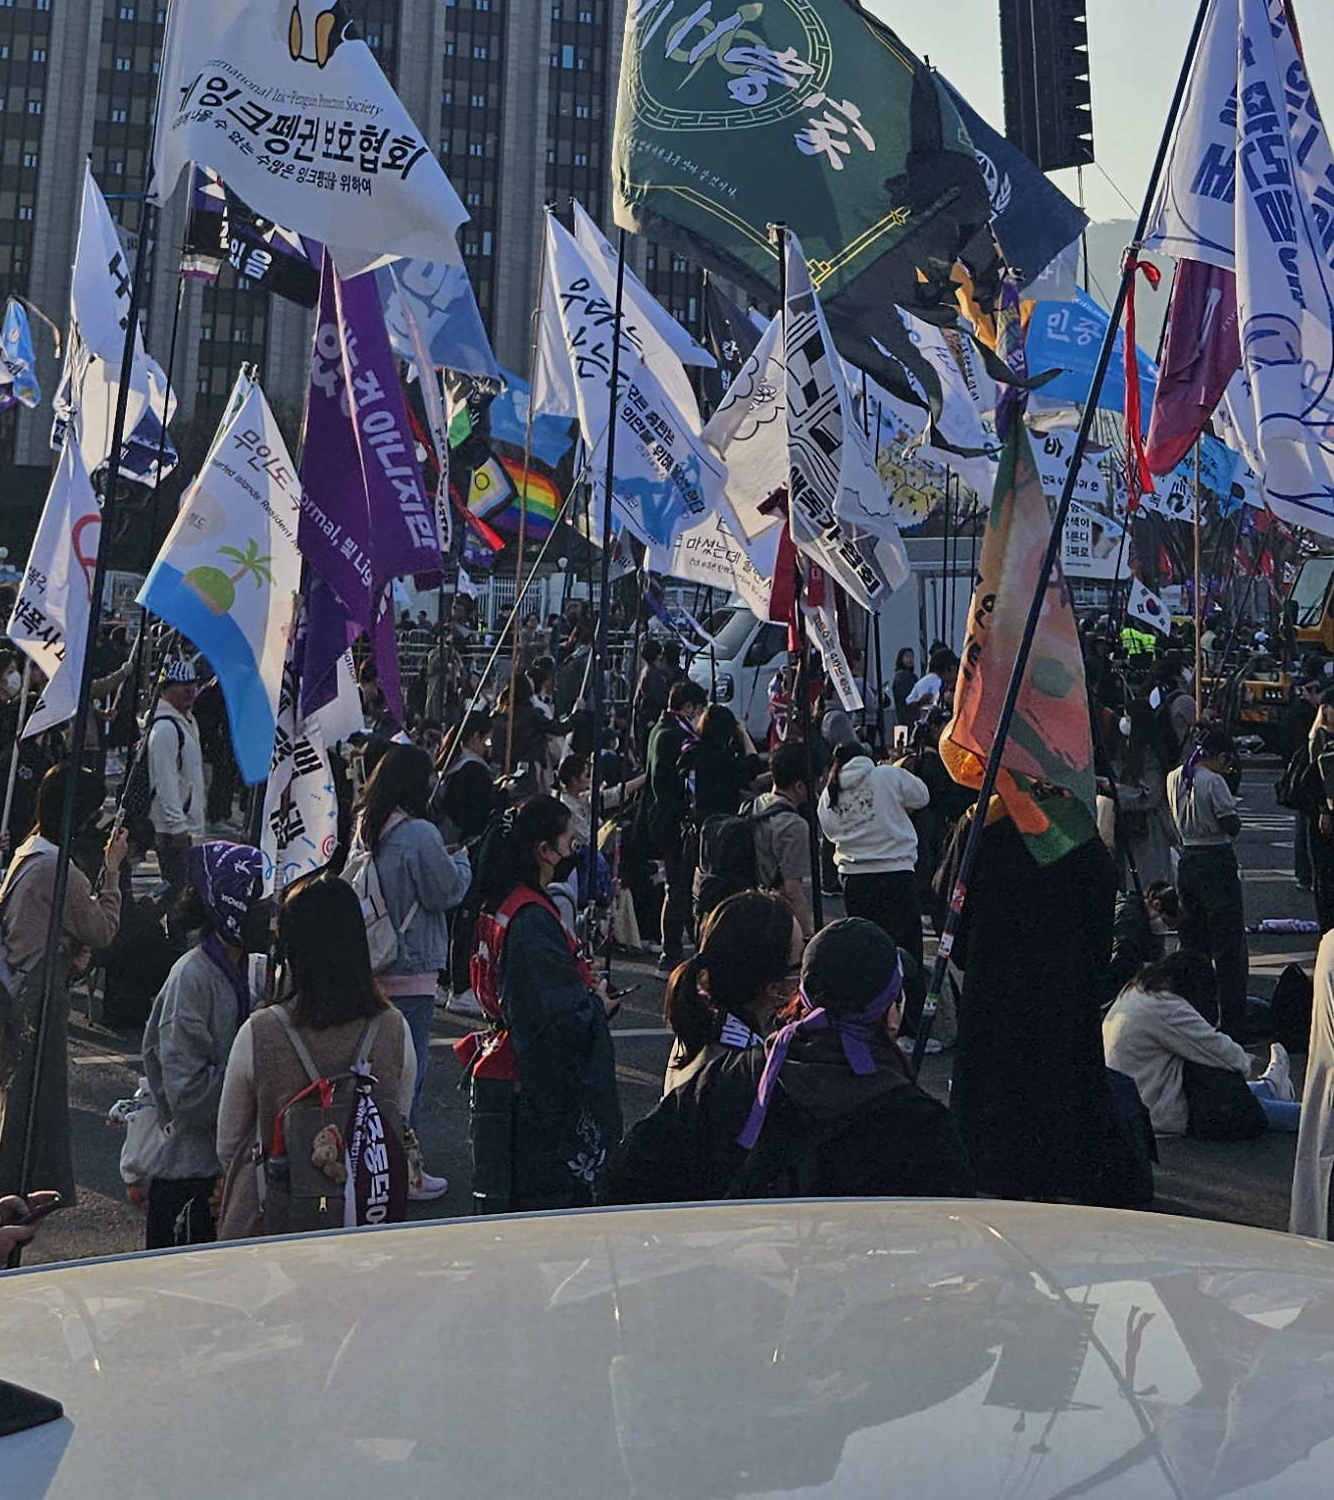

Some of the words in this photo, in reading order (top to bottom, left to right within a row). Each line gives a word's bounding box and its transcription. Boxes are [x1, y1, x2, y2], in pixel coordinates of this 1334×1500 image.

[345, 98, 384, 119] Society
[213, 117, 228, 131] 수
[228, 130, 253, 156] 없는
[256, 154, 296, 181] 수많은
[340, 174, 373, 197] 위하여
[1046, 307, 1103, 346] 민중
[233, 429, 294, 491] 무인도
[260, 500, 293, 538] Resident
[686, 536, 742, 565] 마셨는데
[839, 537, 884, 601] 협회
